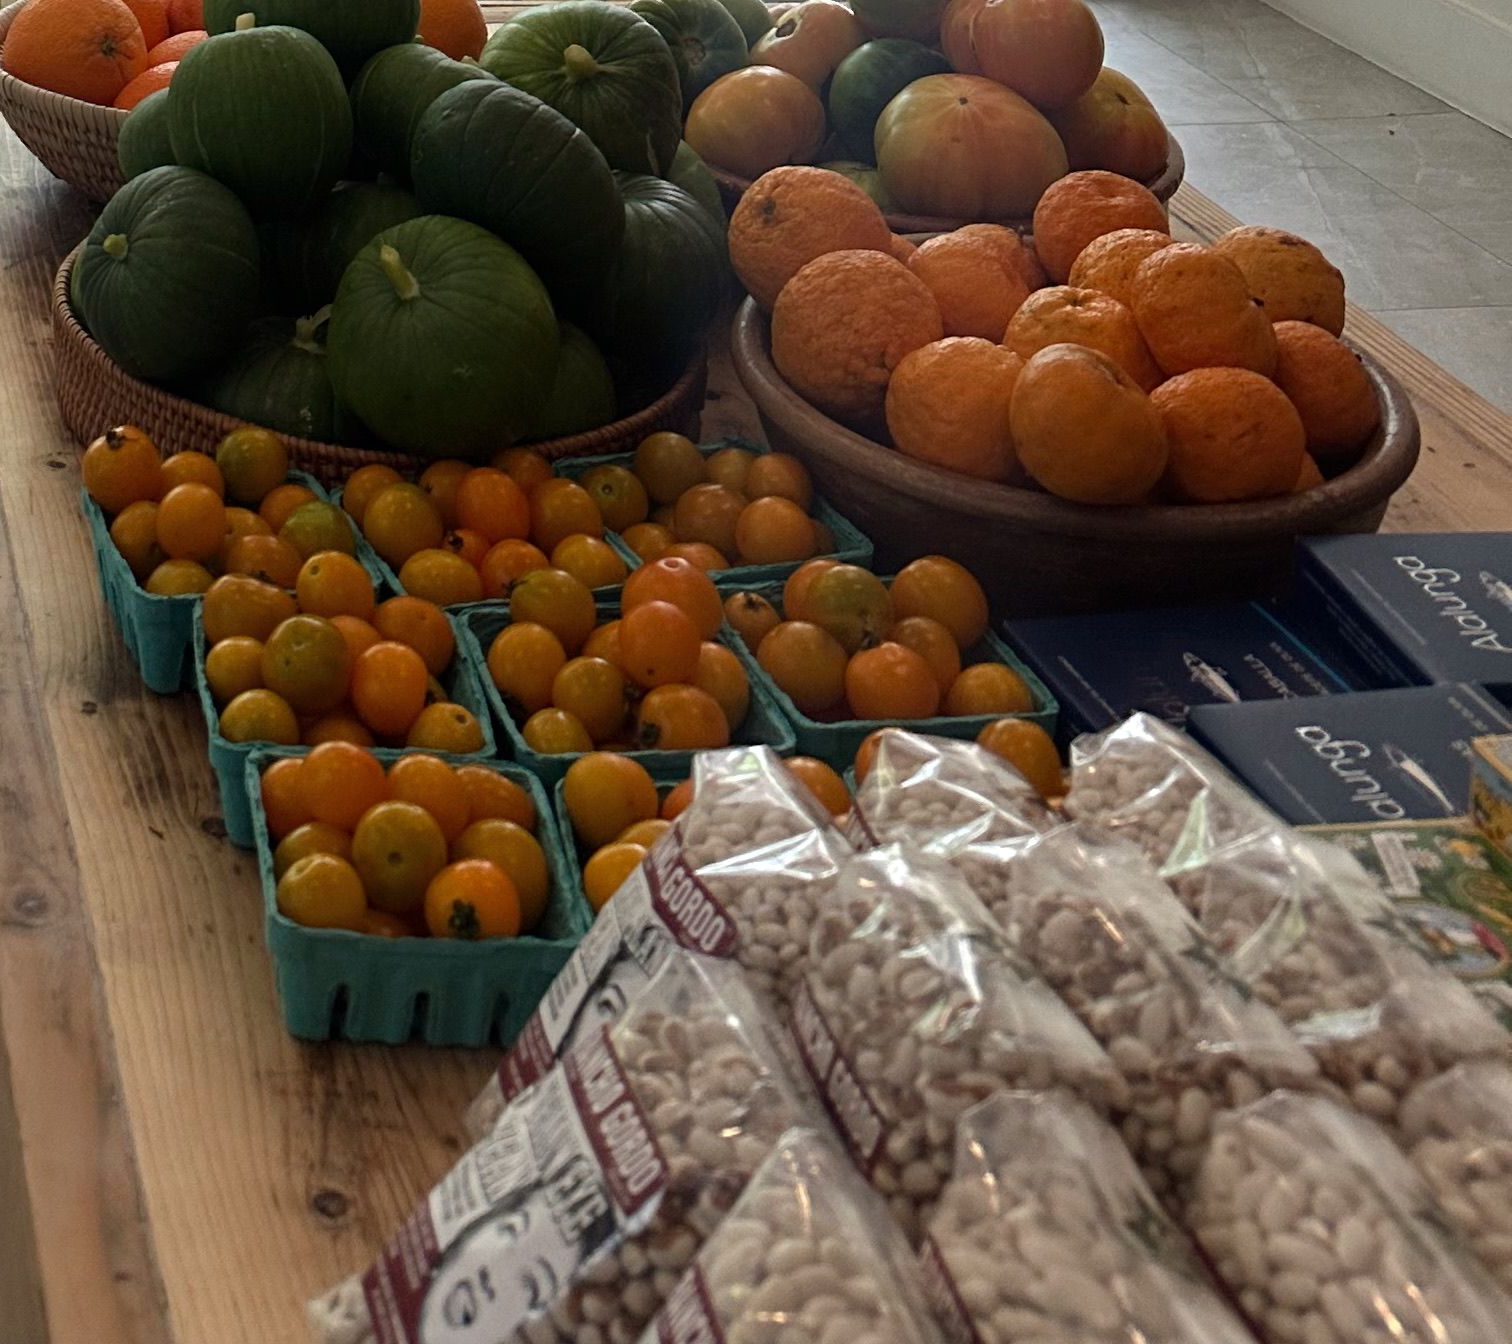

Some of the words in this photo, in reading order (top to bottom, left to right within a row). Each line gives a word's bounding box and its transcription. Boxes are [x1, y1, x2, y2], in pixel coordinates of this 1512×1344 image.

[1392, 555, 1512, 654] Alalunga
[1294, 725, 1406, 819] alunga
[659, 868, 727, 953] GORDO
[598, 1099, 662, 1196] GORDO
